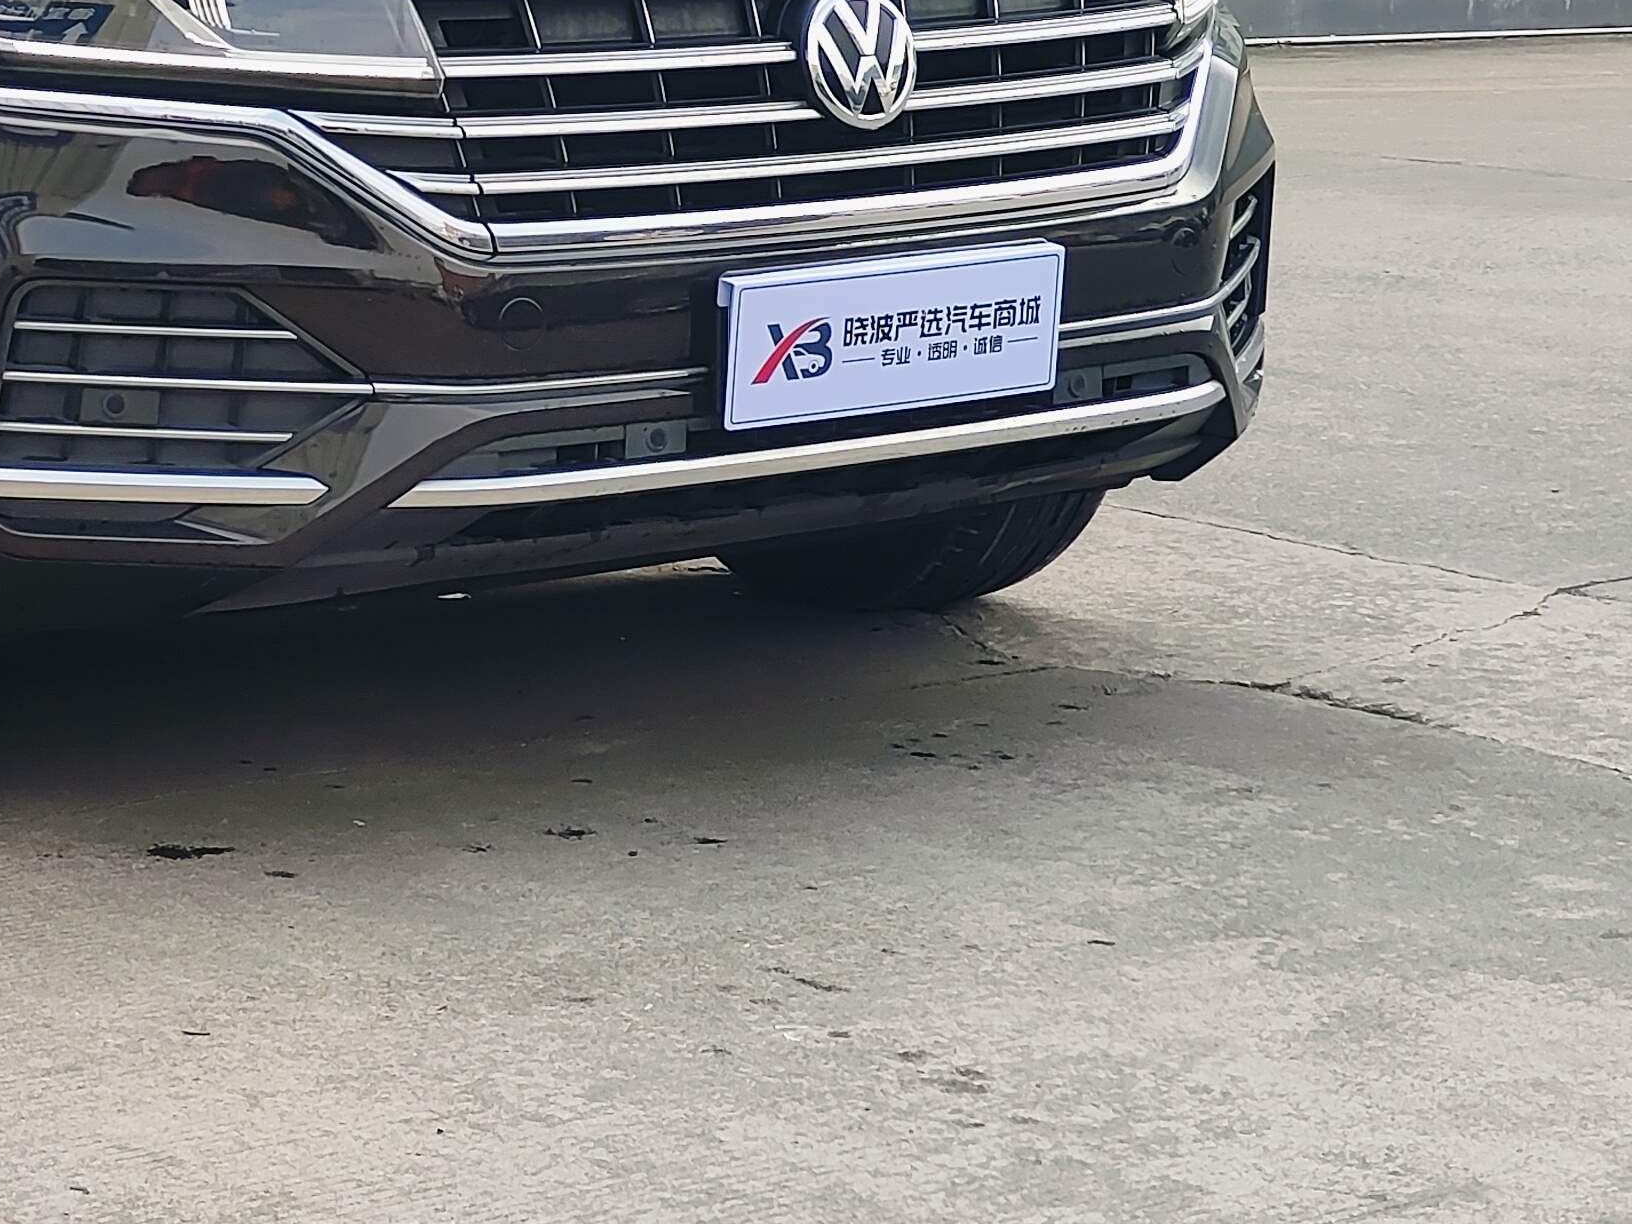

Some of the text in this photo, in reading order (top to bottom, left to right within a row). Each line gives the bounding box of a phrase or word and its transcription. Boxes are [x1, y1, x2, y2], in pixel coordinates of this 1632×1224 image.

[843, 295, 1042, 347] 晓波严选汽车商城
